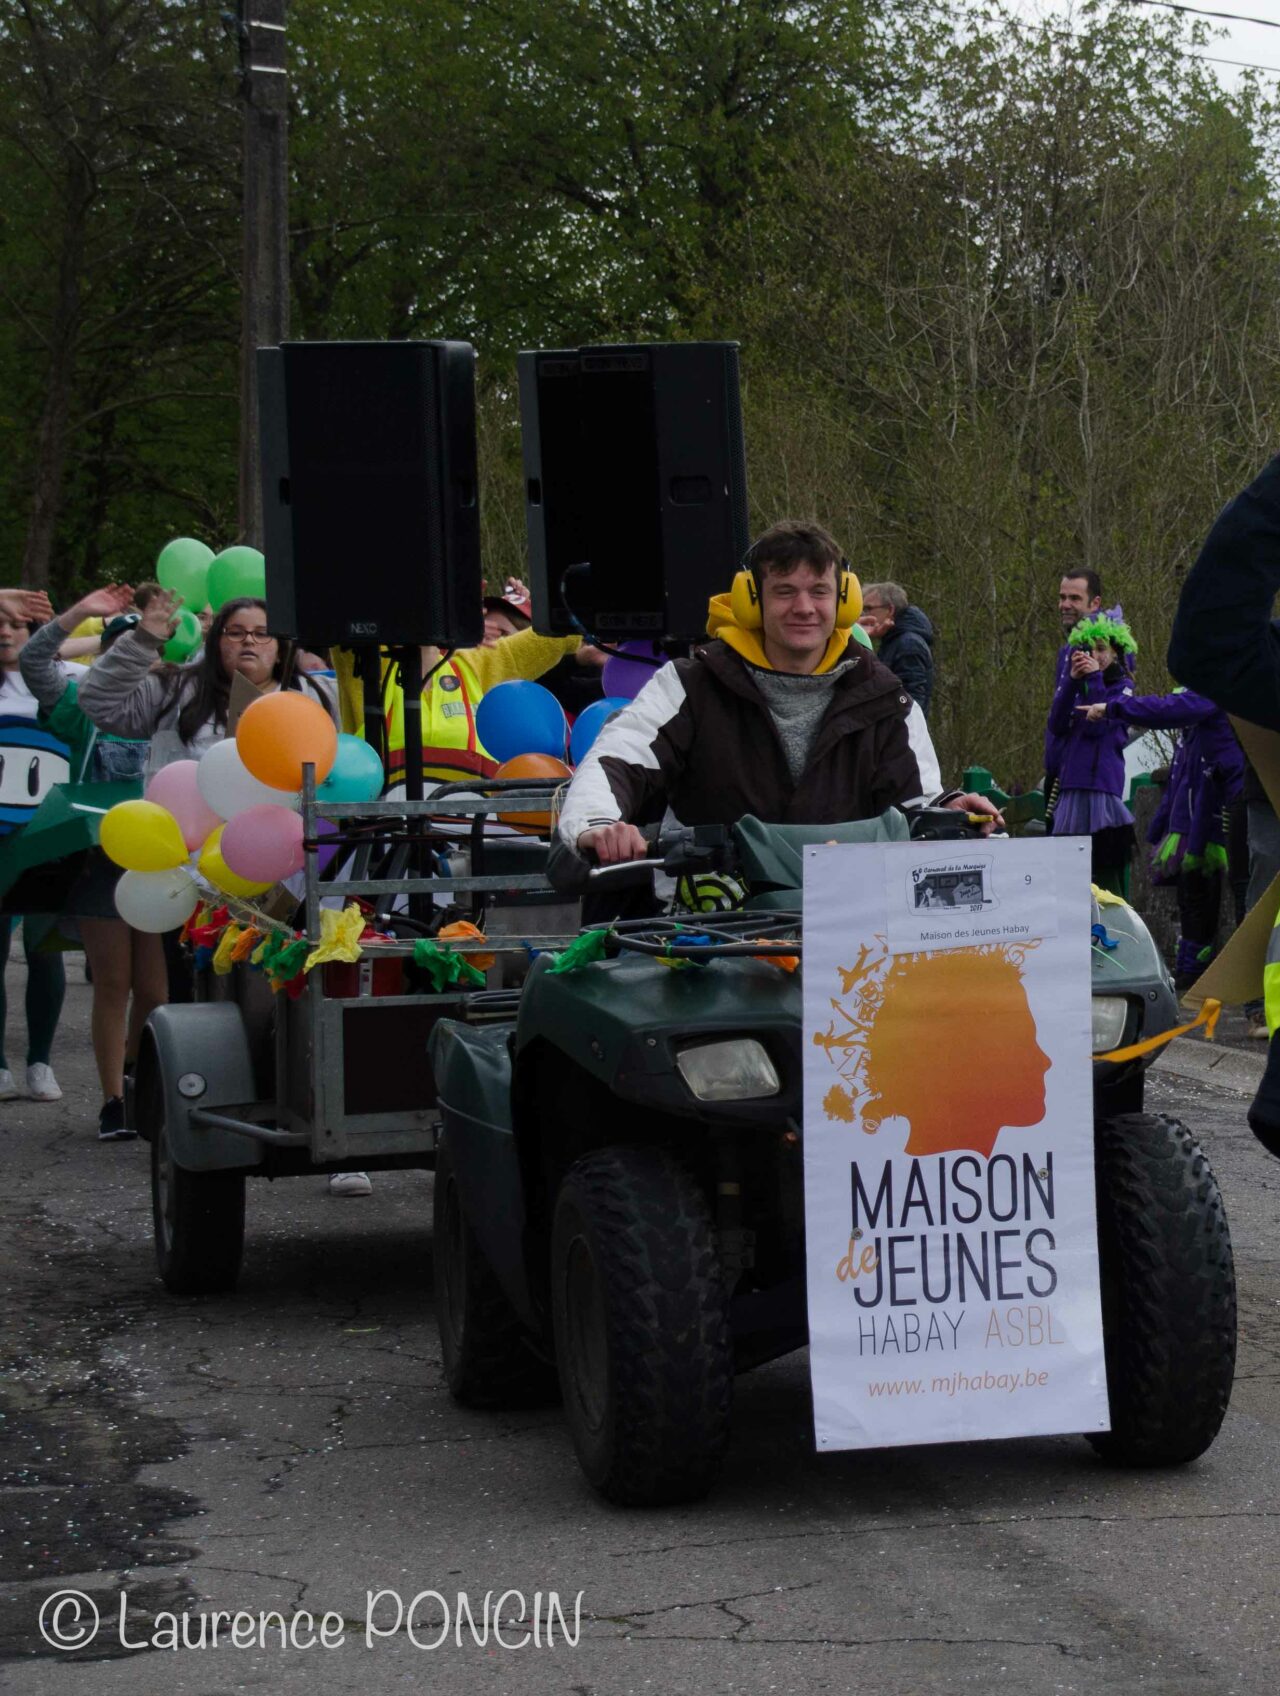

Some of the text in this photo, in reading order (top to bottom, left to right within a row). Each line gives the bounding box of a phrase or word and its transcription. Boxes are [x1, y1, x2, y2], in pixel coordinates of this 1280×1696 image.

[350, 622, 378, 635] NEXO
[1025, 874, 1032, 885] 9
[920, 924, 1030, 941] Maison des Jeunes Habay
[851, 1151, 1055, 1230] MAISON
[835, 1228, 1057, 1308] de JEUNES
[858, 1305, 1065, 1356] HABAY ASBL
